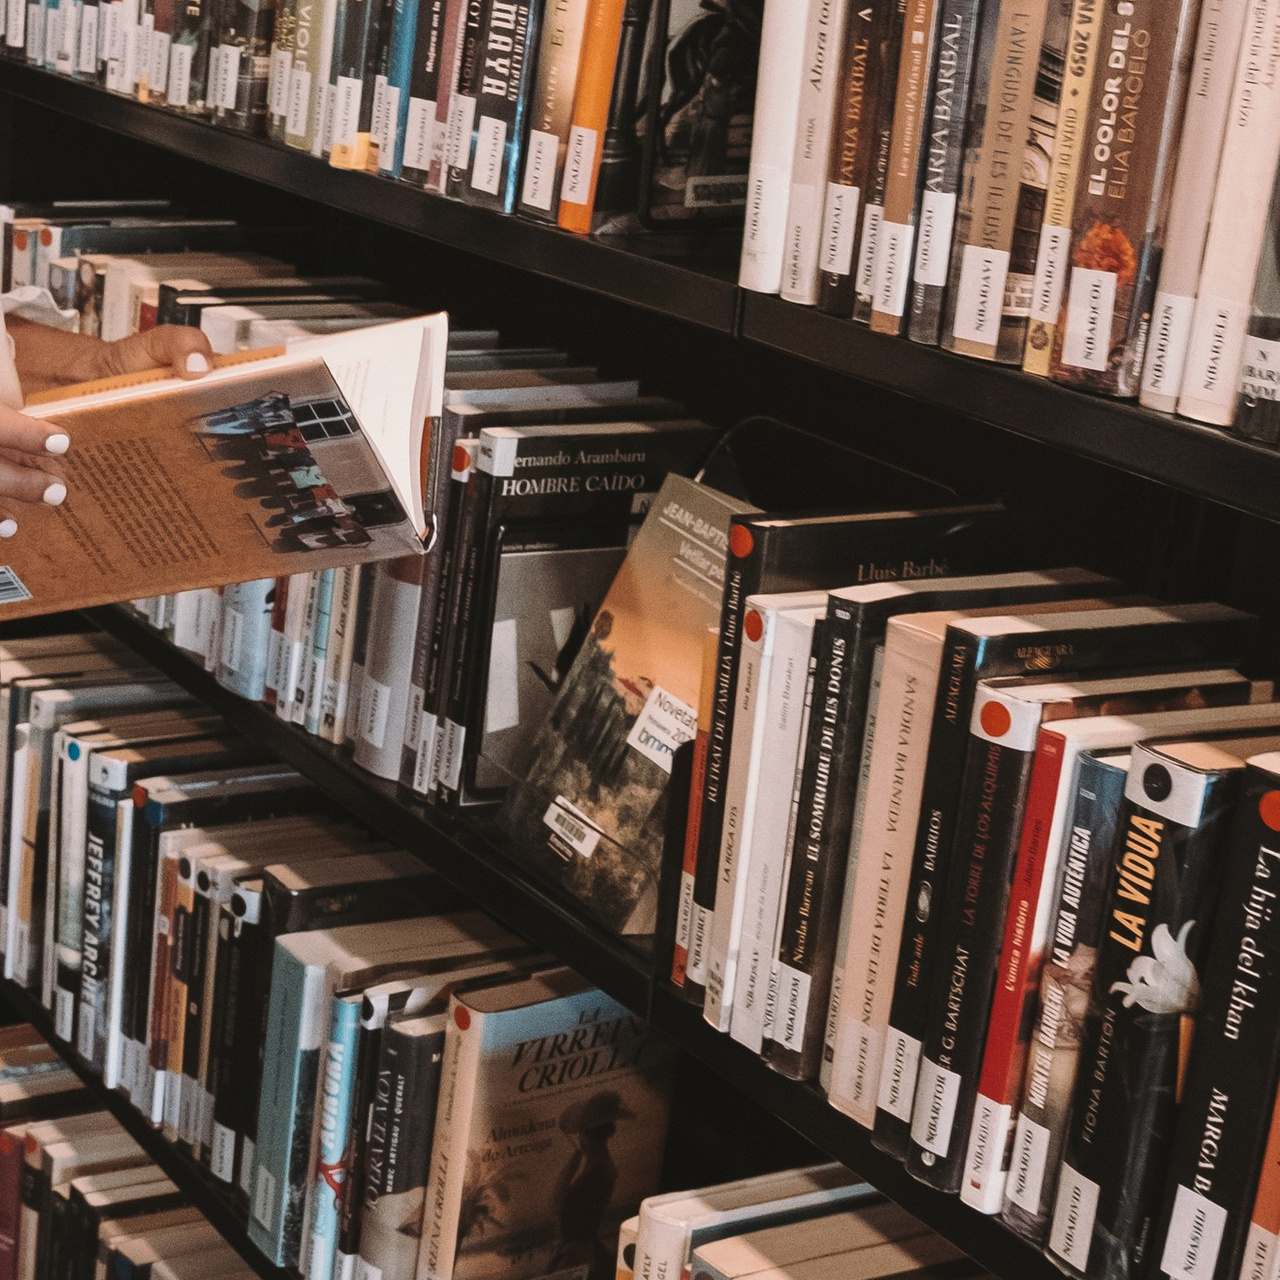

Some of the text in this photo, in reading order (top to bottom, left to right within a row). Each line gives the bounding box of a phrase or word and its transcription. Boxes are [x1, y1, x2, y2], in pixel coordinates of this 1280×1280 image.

[424, 32, 438, 73] Mujeres
[482, 0, 518, 98] MAYA
[809, 32, 827, 92] Ahora
[847, 38, 869, 121] BARBAL
[933, 14, 962, 118] BARBAL
[1070, 30, 1090, 78] 2059
[1108, 22, 1132, 69] DEL
[1062, 108, 1076, 148] CIUTAT
[1094, 68, 1122, 163] COLOR
[991, 149, 1008, 180] LES
[1087, 169, 1108, 196] EL
[1108, 150, 1131, 200] ELIA
[501, 475, 646, 497] HOMBRE CAÍDO
[575, 449, 646, 466] Aramburu
[707, 755, 722, 803] RETRAT
[729, 570, 743, 610] Barbé
[944, 644, 967, 725] ALFAGUARA
[807, 636, 847, 862] EL SOMRIURE DE LES DONES
[873, 674, 918, 932] SANDRA BARNEDA TERRA
[923, 809, 943, 872] BARRIOS
[79, 829, 106, 1004] JEFFREY ARCHE
[793, 870, 814, 963] Nicolas Barreau
[1053, 826, 1092, 969] LA VIDA AUTÈNTICA
[1109, 815, 1164, 953] LA VÍDUA
[692, 908, 706, 969] N(BAR)RET
[1011, 899, 1029, 946] història
[1224, 843, 1275, 1041] La hija del khan
[785, 977, 801, 1044] N(BAR)SOM
[944, 945, 970, 1036] BARTSCHAT
[889, 1037, 906, 1107] N(BAR)TOD
[1028, 1052, 1054, 1109] MONTSE
[1082, 1008, 1117, 1144] FIONA BARTON
[386, 1074, 405, 1194] MARC ARTIGAU QUERALT
[926, 1074, 946, 1145] N(BAR)TOR
[1201, 1088, 1229, 1167] MARGA
[1016, 1129, 1034, 1198] N(BAR)VID
[1063, 1186, 1082, 1256] N(BAR)VID
